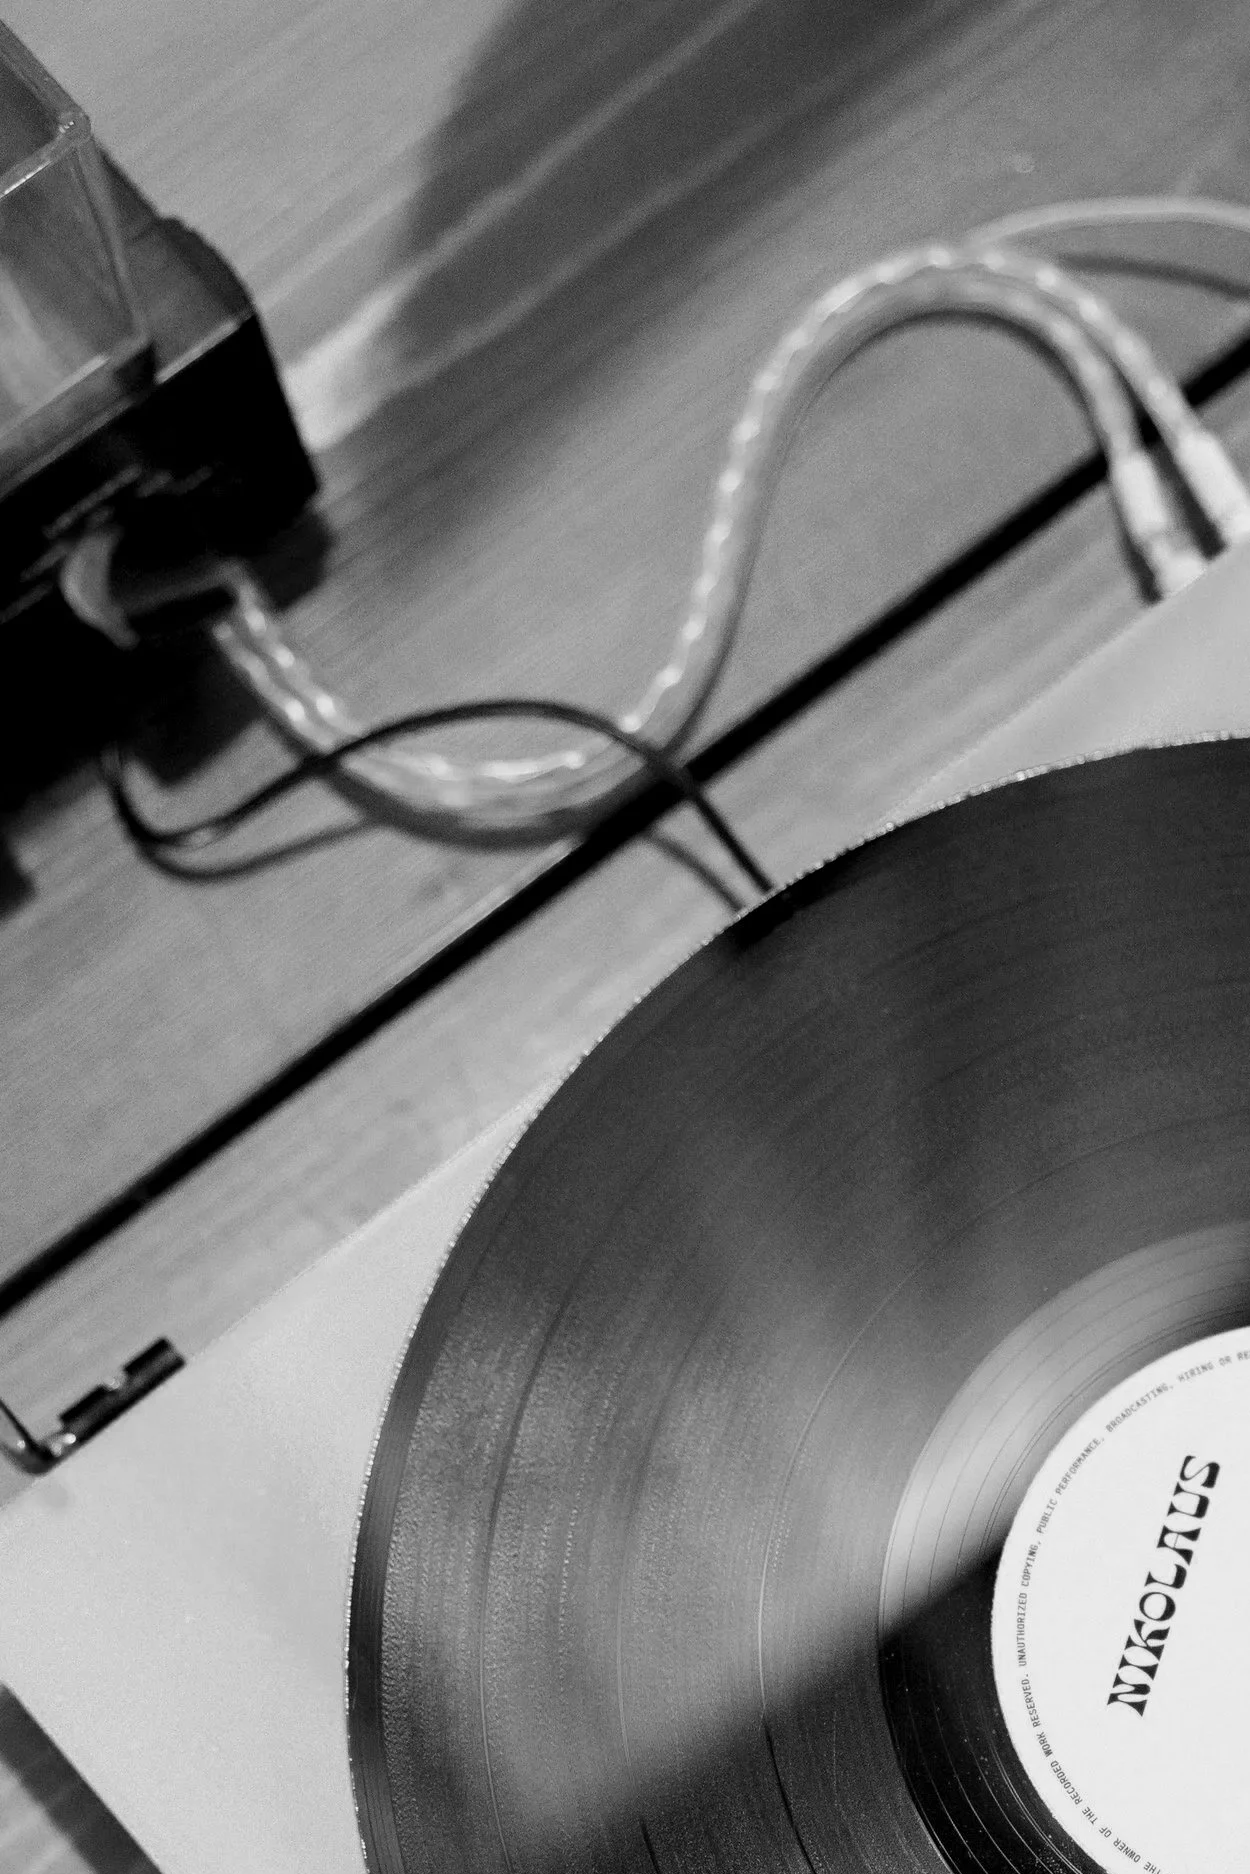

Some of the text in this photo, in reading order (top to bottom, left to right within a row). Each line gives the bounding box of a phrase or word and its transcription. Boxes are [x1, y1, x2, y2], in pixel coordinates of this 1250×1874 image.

[1178, 1361, 1214, 1382] HIRING
[1218, 1355, 1232, 1367] OR
[1035, 1498, 1058, 1535] PUBLIC
[1020, 1541, 1041, 1588] COPYING,
[1108, 1456, 1219, 1716] NIKOLAUS
[1016, 1592, 1028, 1667] UNAUTHORIZED
[1020, 1673, 1042, 1729] RESERVED.
[1036, 1731, 1054, 1758] WORK
[1050, 1760, 1084, 1806] RECORDED
[1081, 1806, 1099, 1826] THE
[1098, 1827, 1113, 1839] OF
[1112, 1837, 1142, 1864] OWNER
